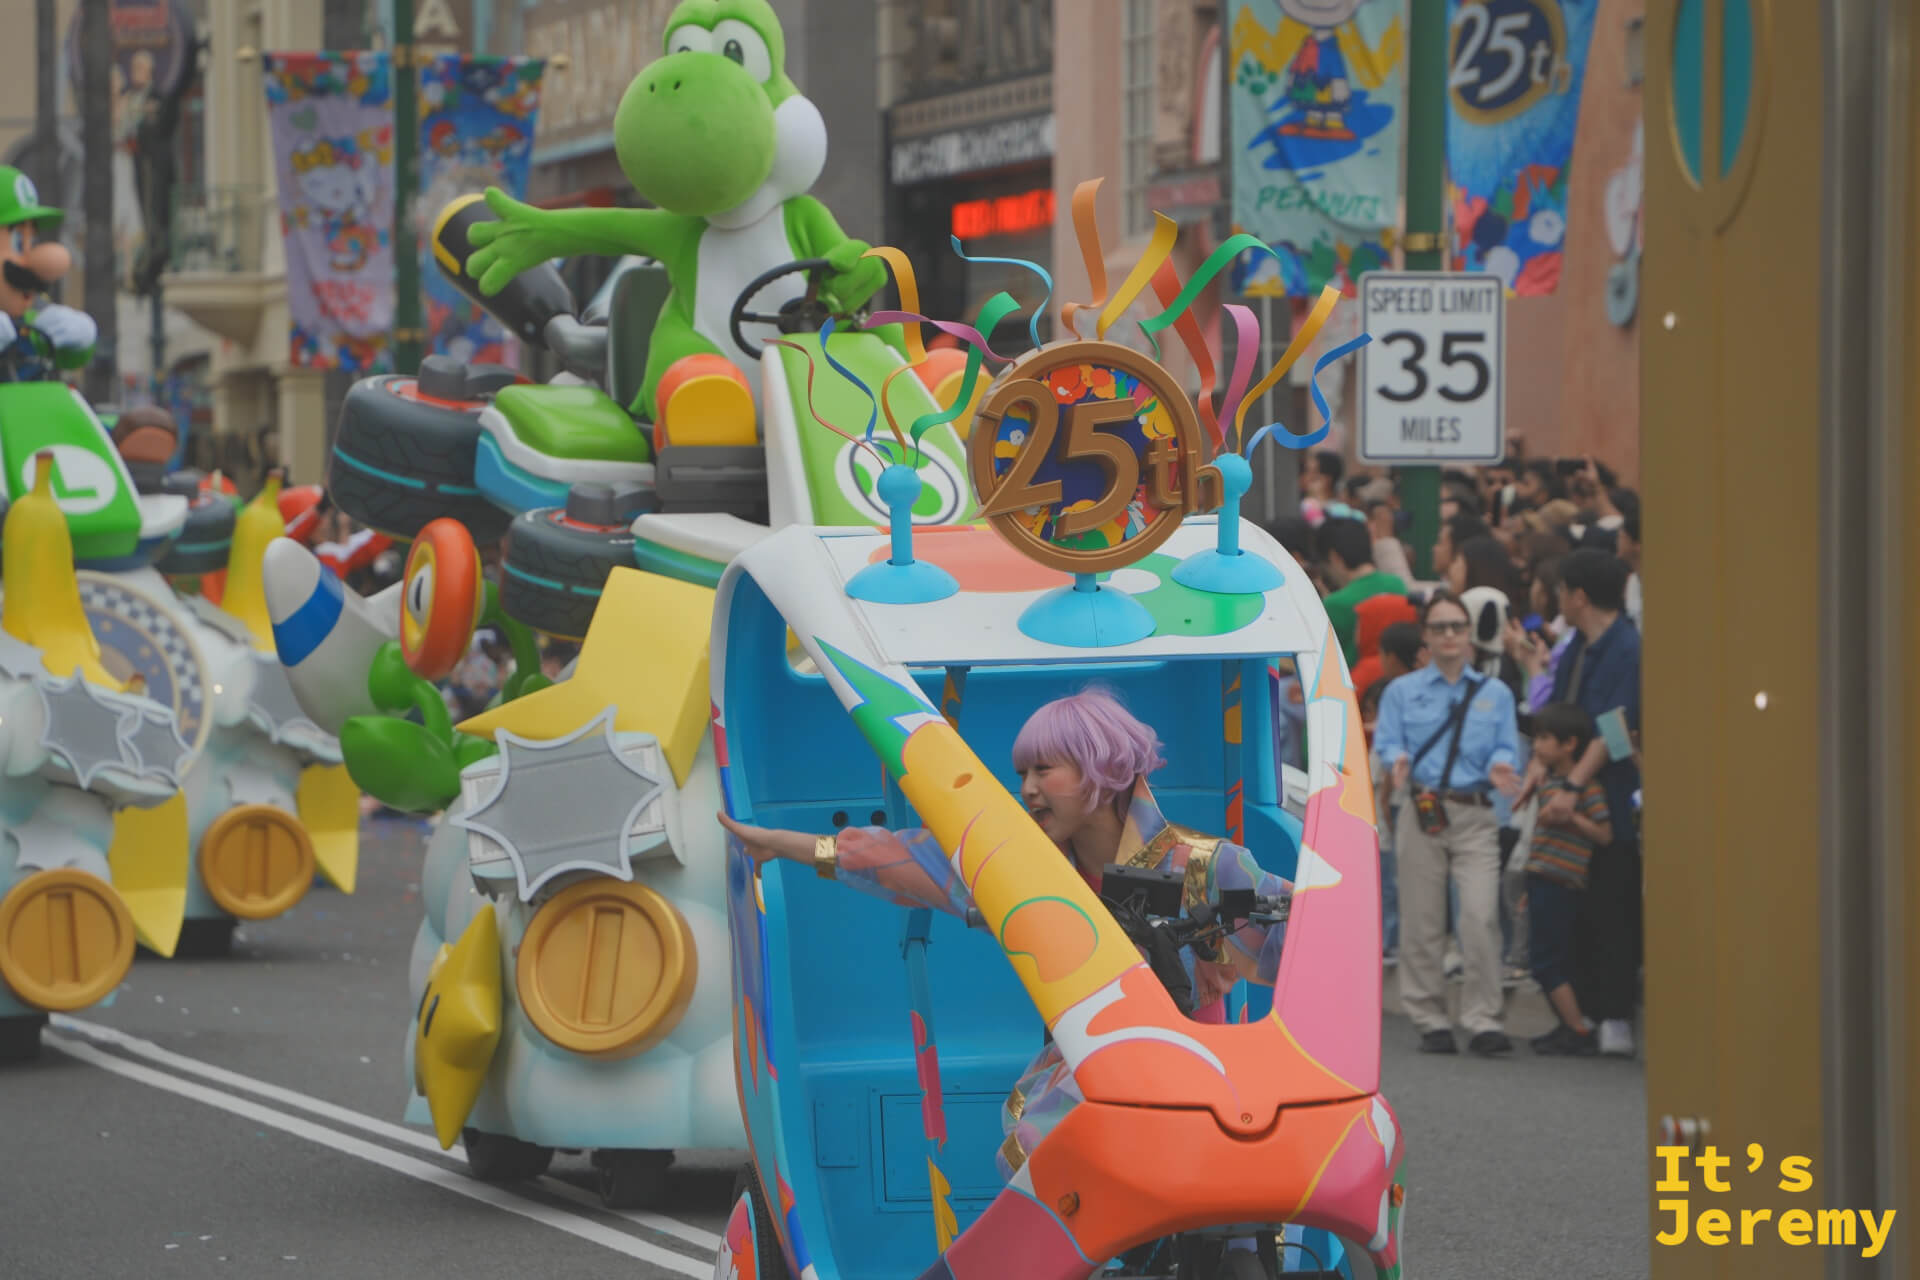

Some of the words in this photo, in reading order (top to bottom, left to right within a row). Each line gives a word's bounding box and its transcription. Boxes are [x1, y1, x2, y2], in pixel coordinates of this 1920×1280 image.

[1450, 3, 1573, 100] 25th
[1255, 184, 1382, 221] PEANUTS
[1371, 287, 1432, 313] SPEED
[1440, 288, 1494, 314] LIMIT
[1377, 330, 1491, 402] 35
[1401, 416, 1461, 443] MILES
[969, 378, 1225, 541] 25th
